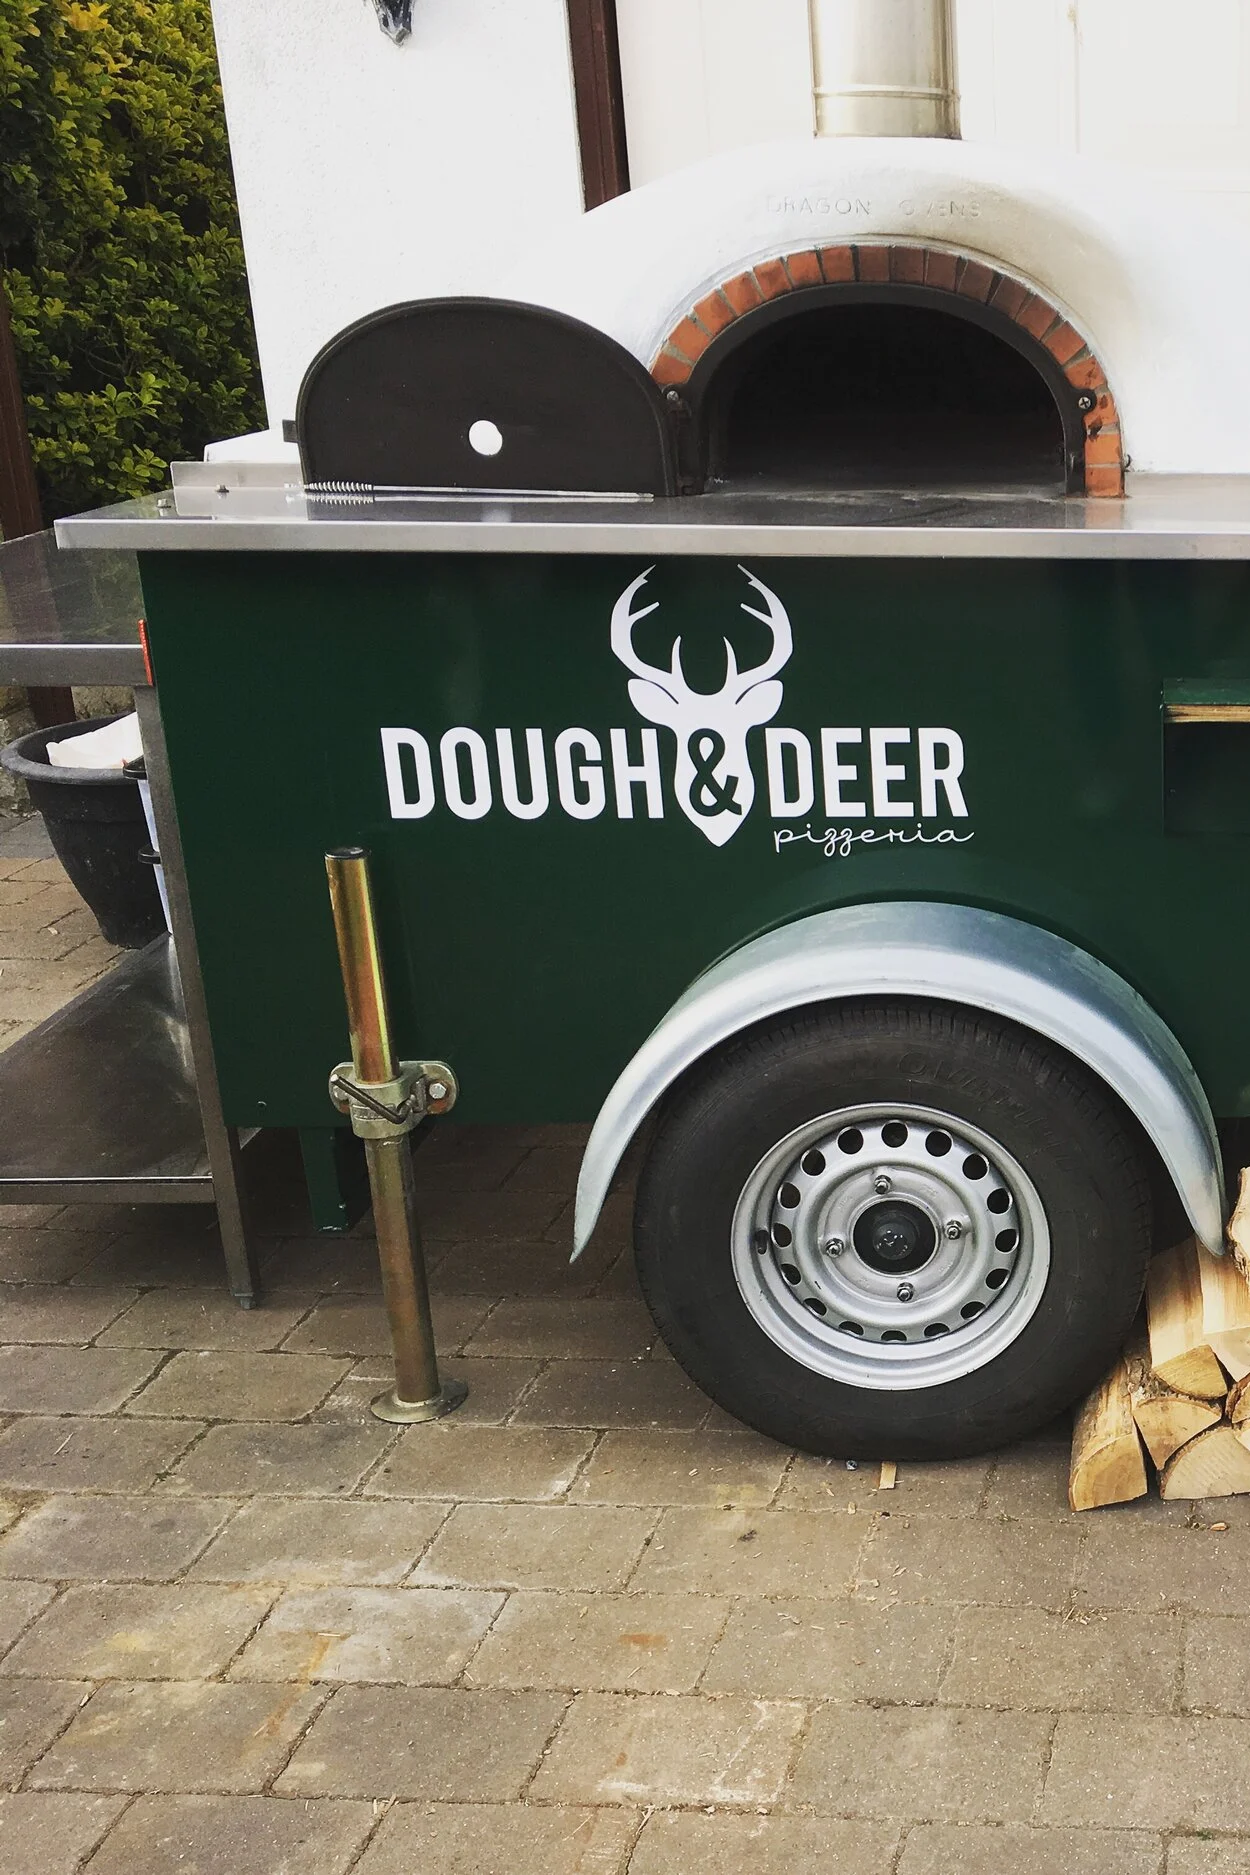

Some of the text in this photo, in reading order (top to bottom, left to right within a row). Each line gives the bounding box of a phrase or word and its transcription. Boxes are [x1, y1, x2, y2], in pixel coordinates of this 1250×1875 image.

[380, 726, 970, 821] DOUGH & DEER
[773, 822, 976, 857] pizzeria
